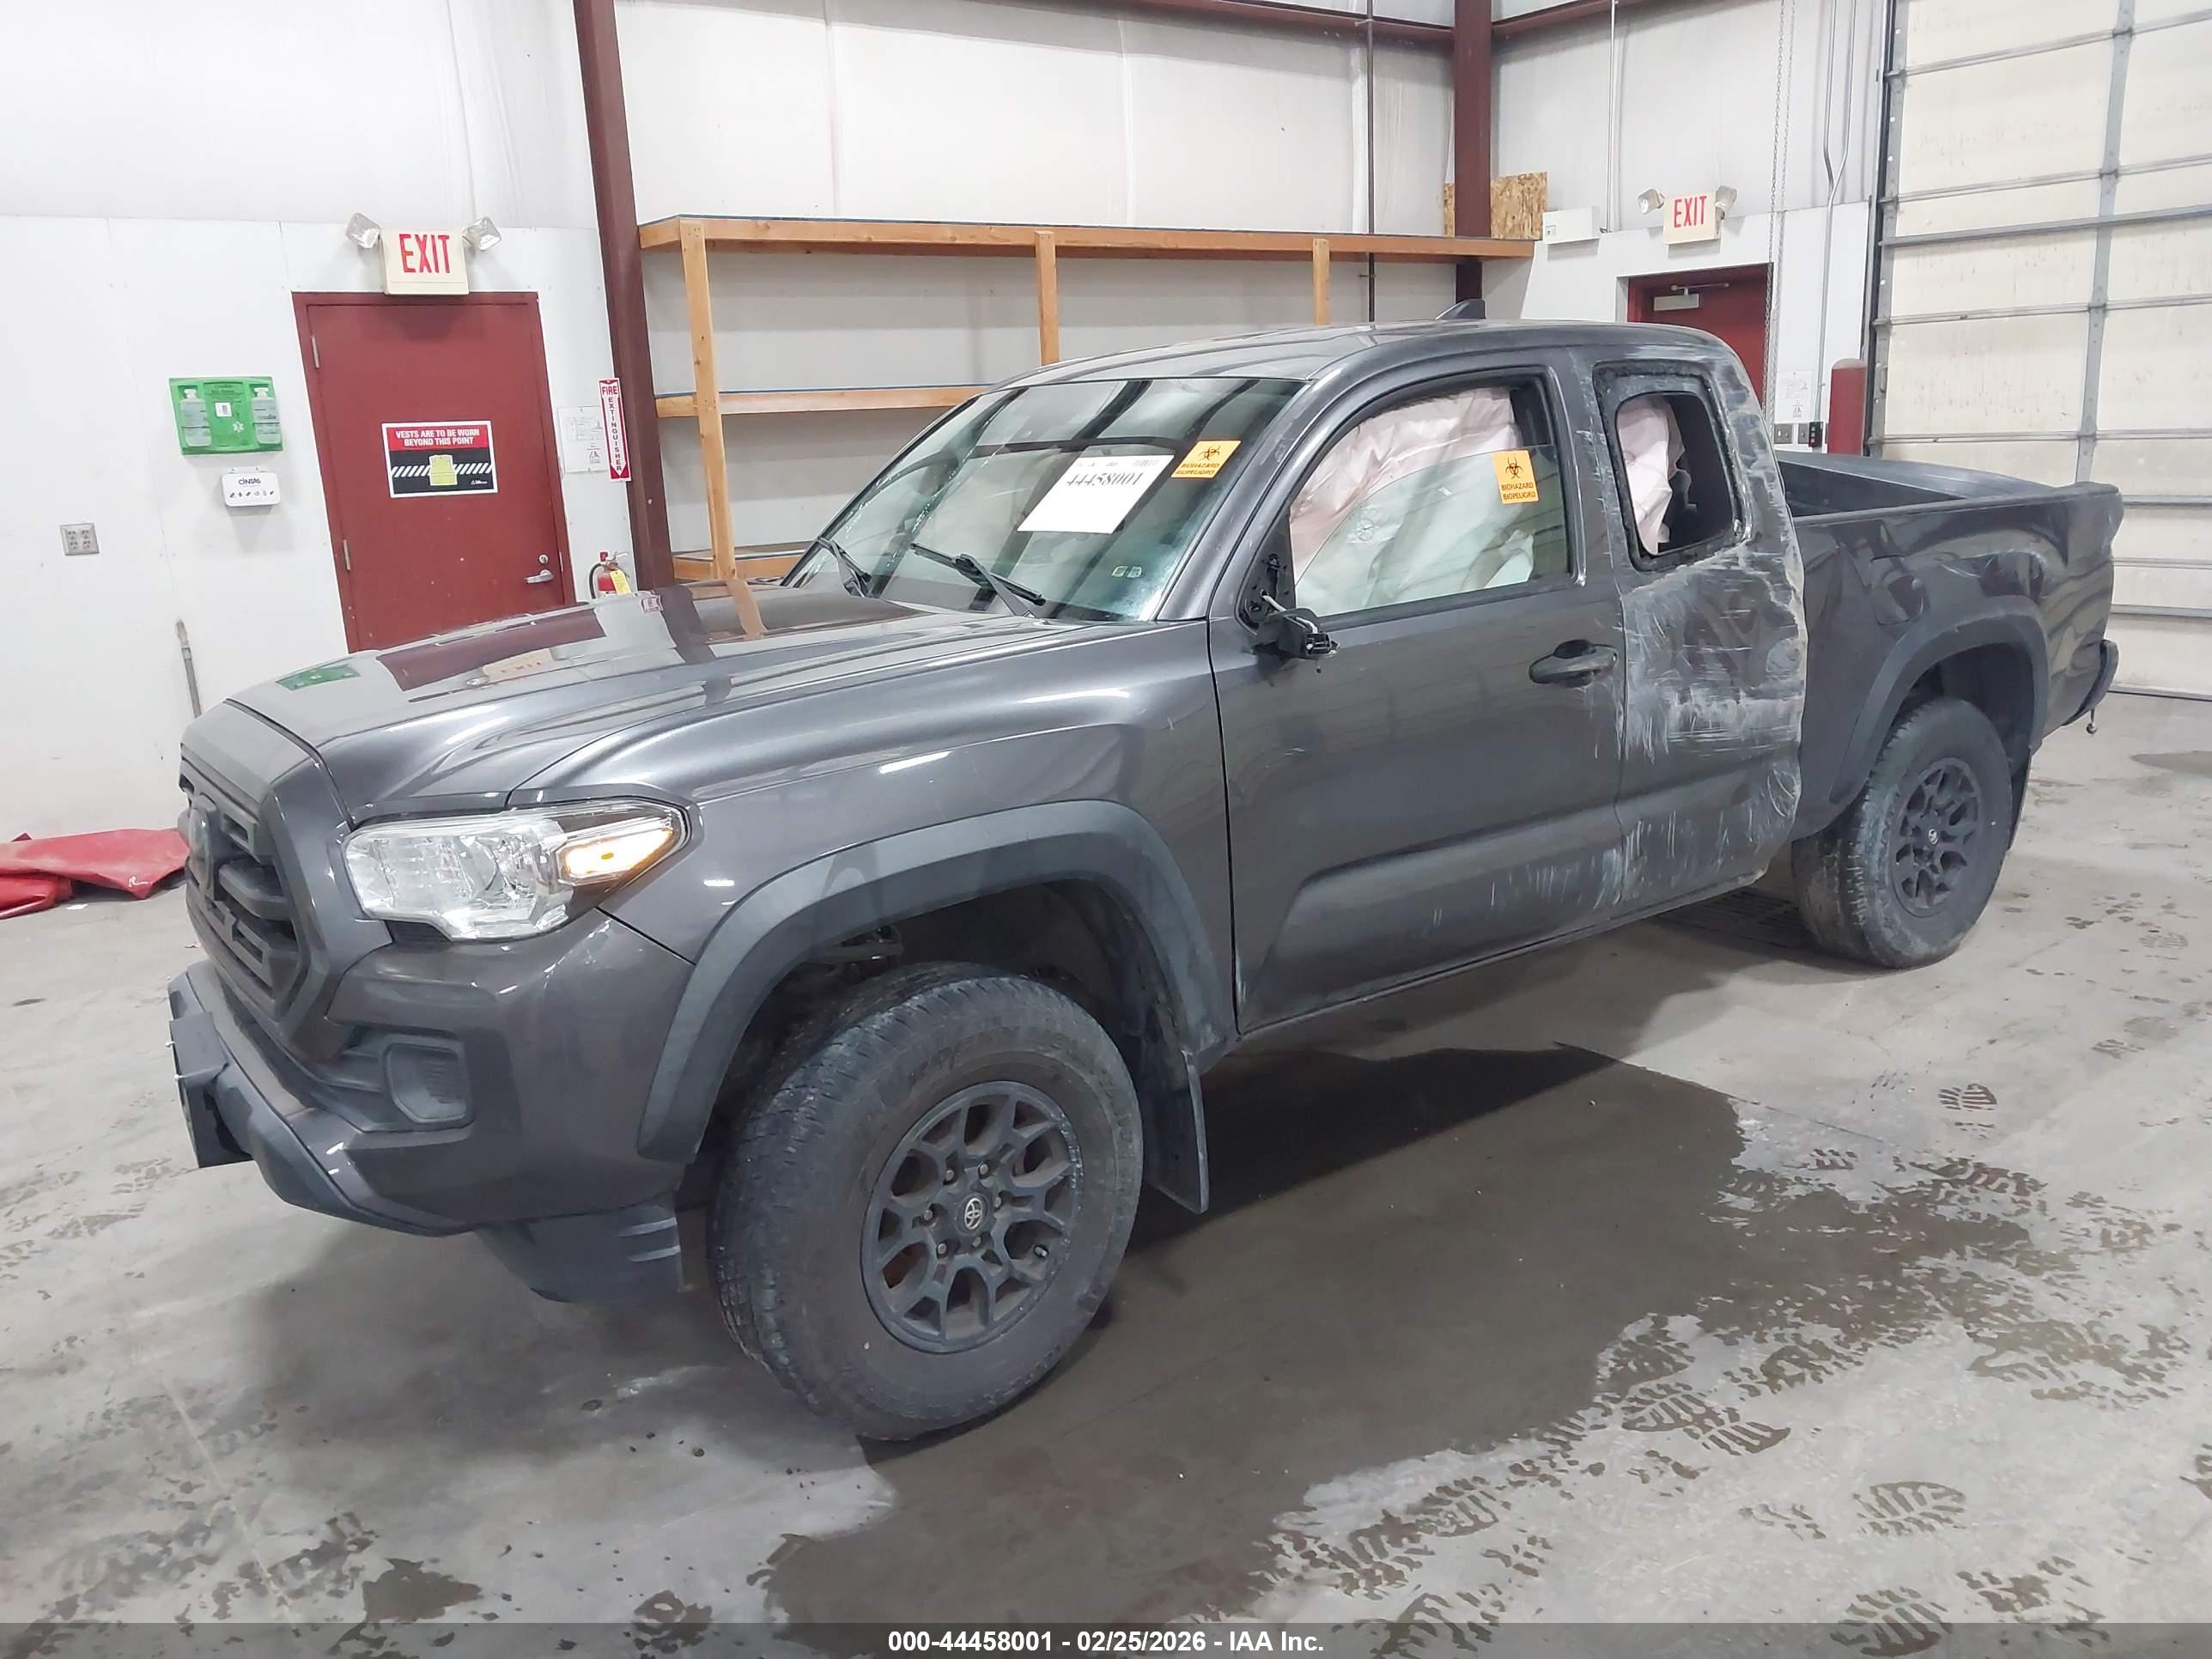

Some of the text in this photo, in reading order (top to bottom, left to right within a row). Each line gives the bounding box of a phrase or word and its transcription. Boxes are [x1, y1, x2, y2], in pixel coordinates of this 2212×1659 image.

[1674, 196, 1707, 228] EXIT
[399, 234, 450, 273] EXIT
[602, 386, 618, 396] FIRE
[396, 430, 419, 439] VESTS
[608, 397, 622, 471] EXTINGUISHER
[404, 436, 474, 447] BEYOND THIS POINT
[1066, 472, 1144, 486] 44458001
[1503, 491, 1536, 500] BIOPELIGRO
